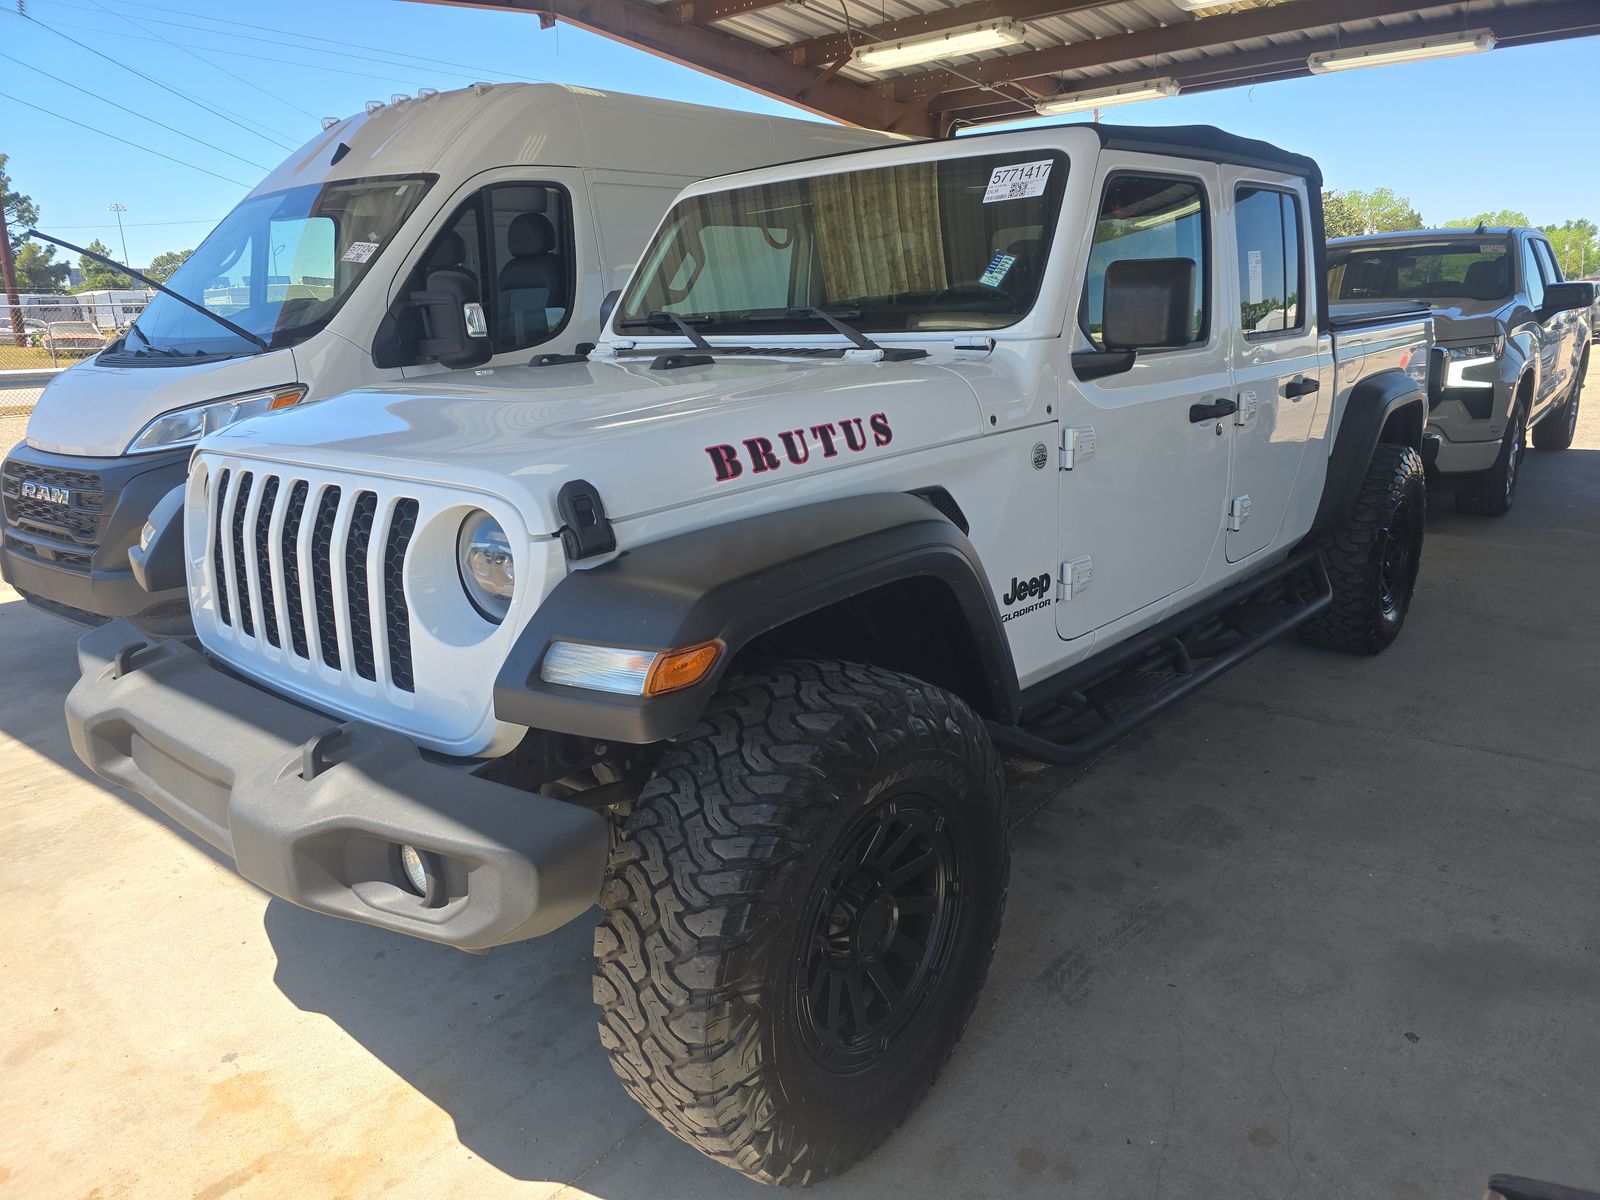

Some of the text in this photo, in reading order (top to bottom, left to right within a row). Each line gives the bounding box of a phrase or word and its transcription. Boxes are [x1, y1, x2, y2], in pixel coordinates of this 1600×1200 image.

[992, 164, 1052, 184] 5771417
[705, 412, 893, 481] BRUTUS
[22, 481, 70, 505] RAM
[1003, 572, 1051, 606] Jeep
[1001, 598, 1051, 623] GLADIATOR
